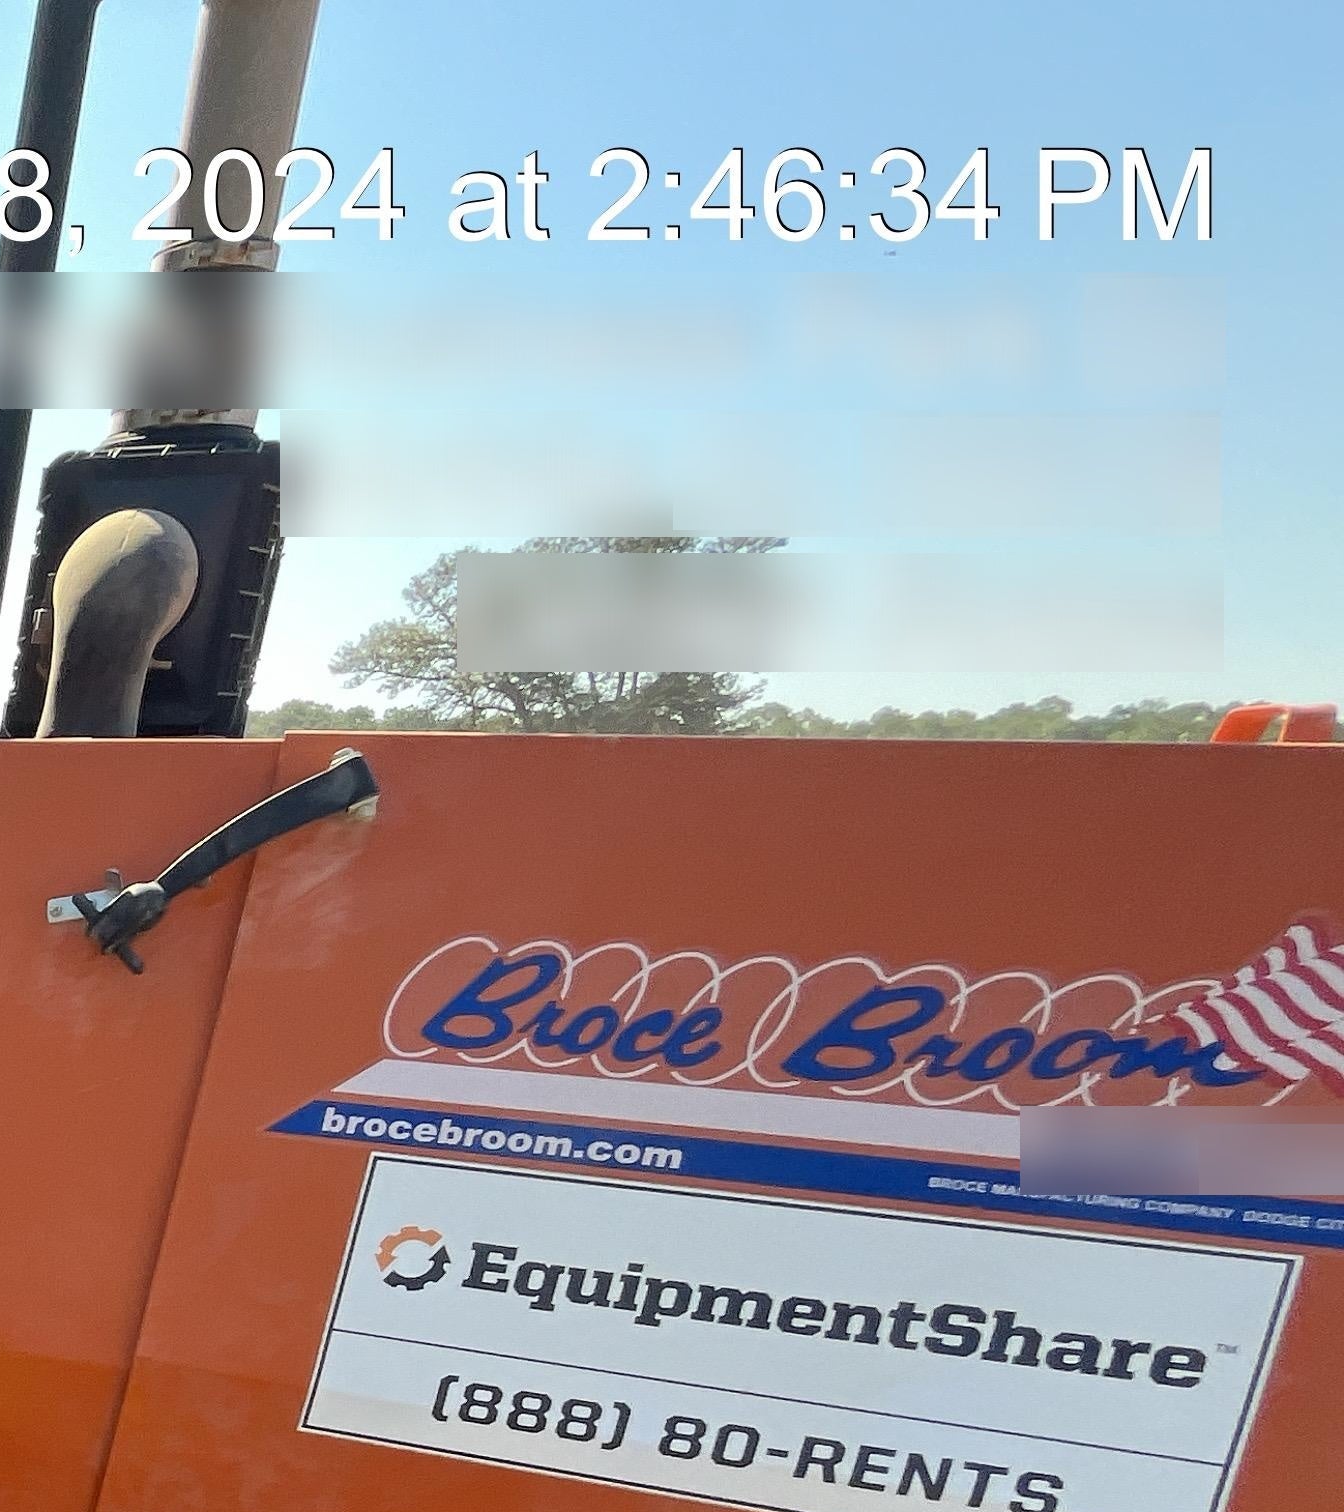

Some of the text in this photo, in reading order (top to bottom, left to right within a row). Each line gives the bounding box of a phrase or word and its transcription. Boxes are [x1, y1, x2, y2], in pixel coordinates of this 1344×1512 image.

[421, 954, 1267, 1088] Broce Broom
[321, 1106, 683, 1169] brocebroom.com
[461, 1242, 1207, 1389] EquipmentShare
[430, 1374, 632, 1452] (888)
